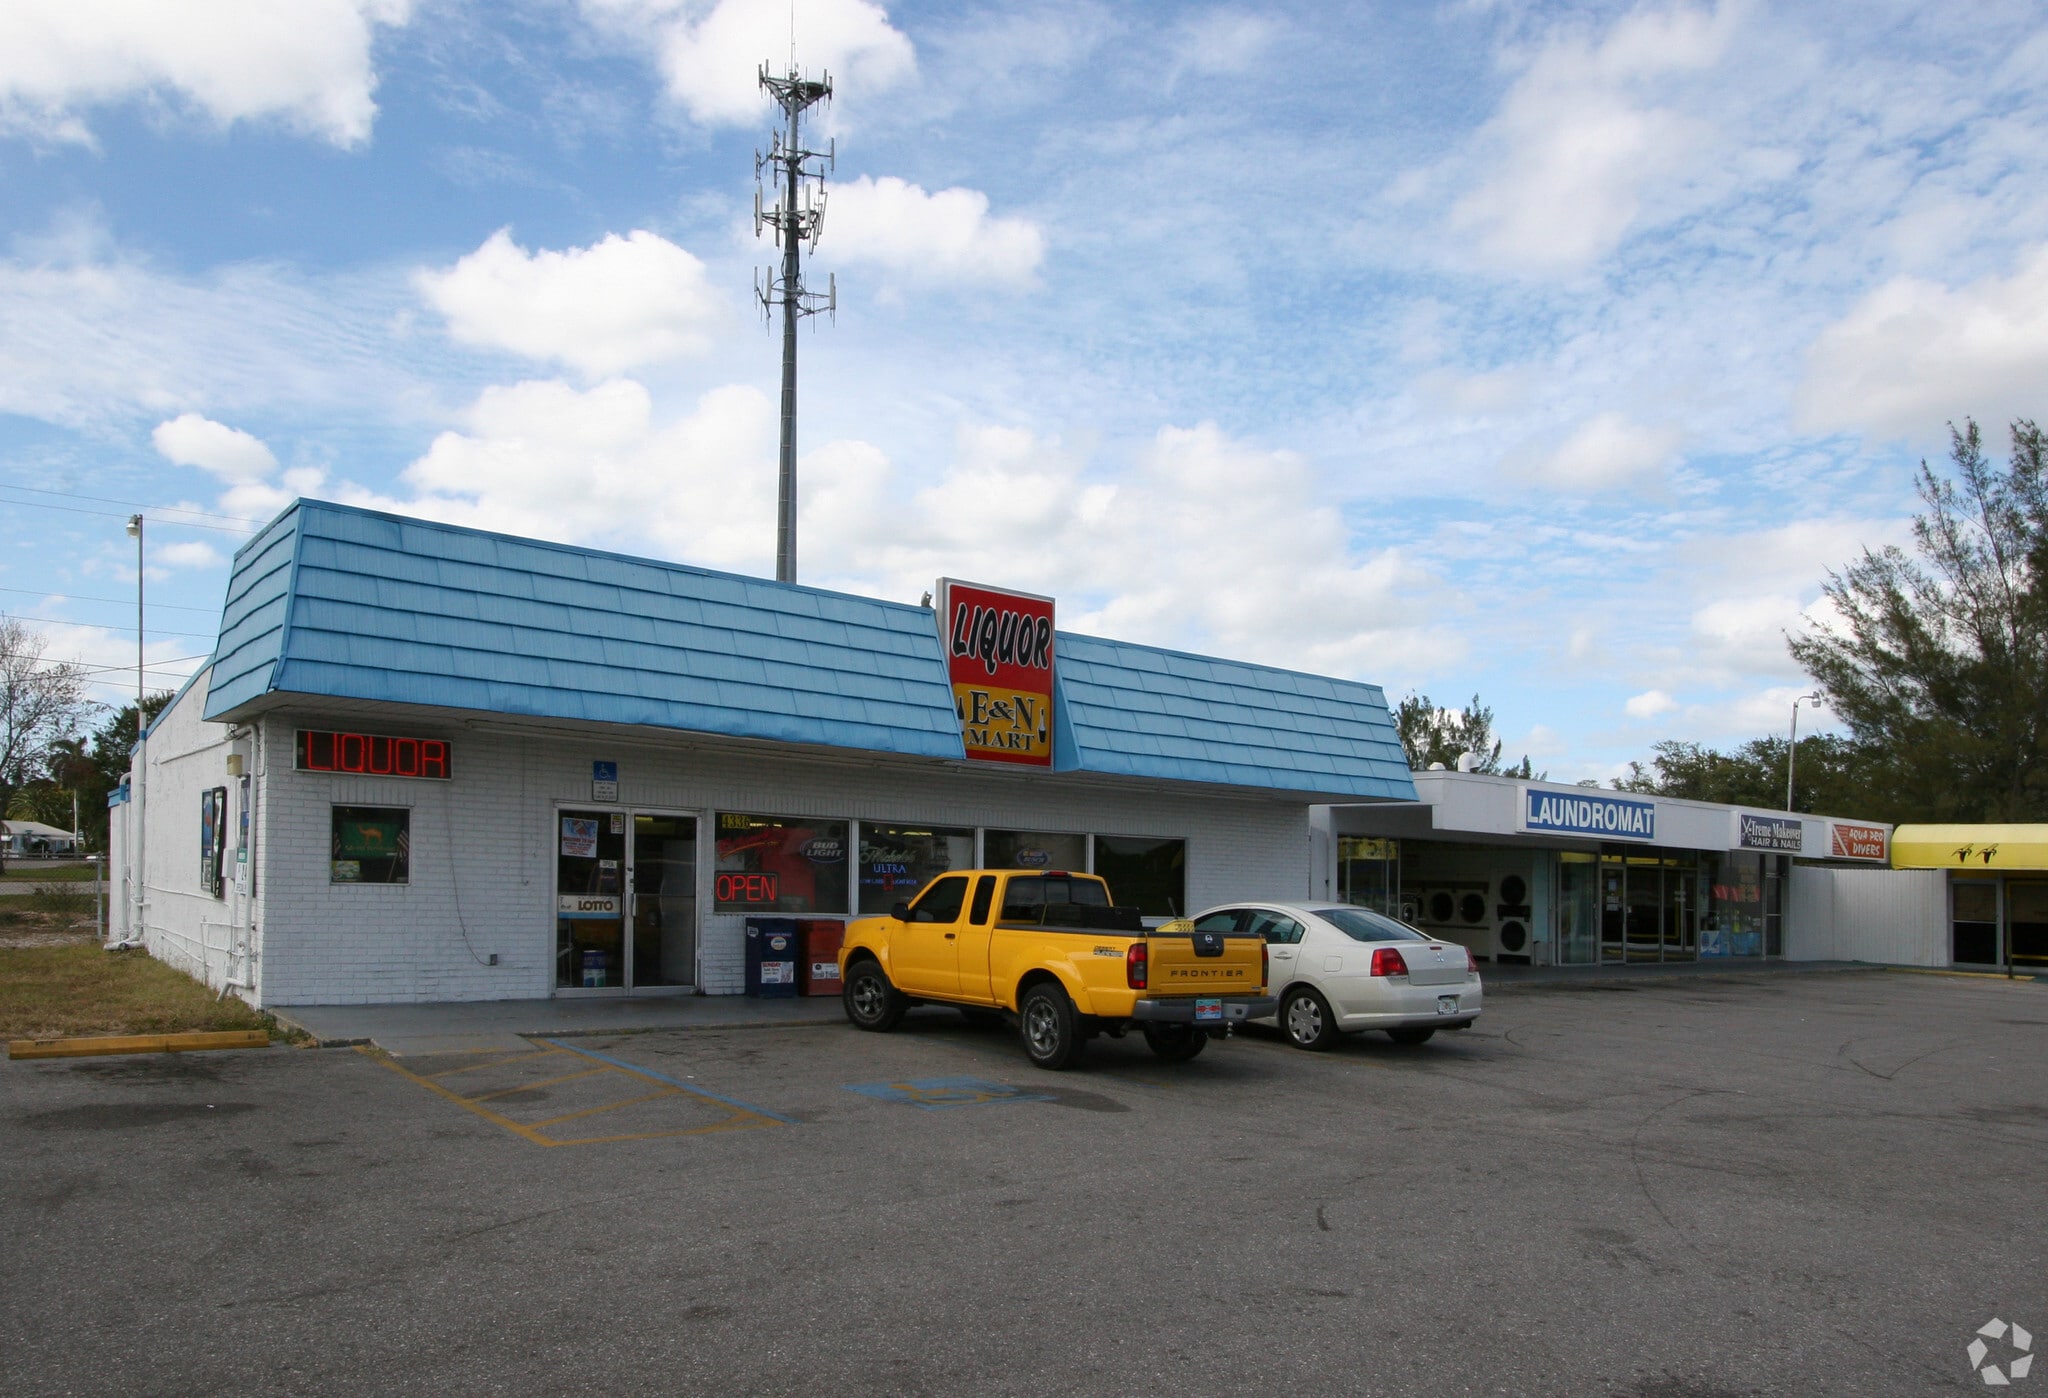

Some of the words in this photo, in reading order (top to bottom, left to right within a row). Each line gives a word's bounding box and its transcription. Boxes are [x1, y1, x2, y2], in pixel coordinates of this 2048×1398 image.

[951, 602, 1052, 675] LIQUOR
[969, 690, 1035, 731] E&N
[967, 728, 1035, 752] MART
[308, 731, 445, 778] LIQUOR
[1527, 795, 1654, 834] LAUNDROMAT
[1772, 820, 1801, 840] Makeover
[1849, 828, 1868, 841] AQUA
[1869, 831, 1884, 842] PRO
[812, 841, 840, 849] BUD
[1751, 837, 1771, 847] HAIR
[1772, 838, 1779, 848] &
[1780, 839, 1801, 849] NAILS
[1853, 842, 1880, 856] DIVERS
[807, 849, 844, 857] LIGHT
[873, 863, 907, 874] ULTRA
[716, 874, 776, 902] OPEN
[578, 900, 614, 911] LOTTO
[1170, 969, 1244, 977] FRONTIER
